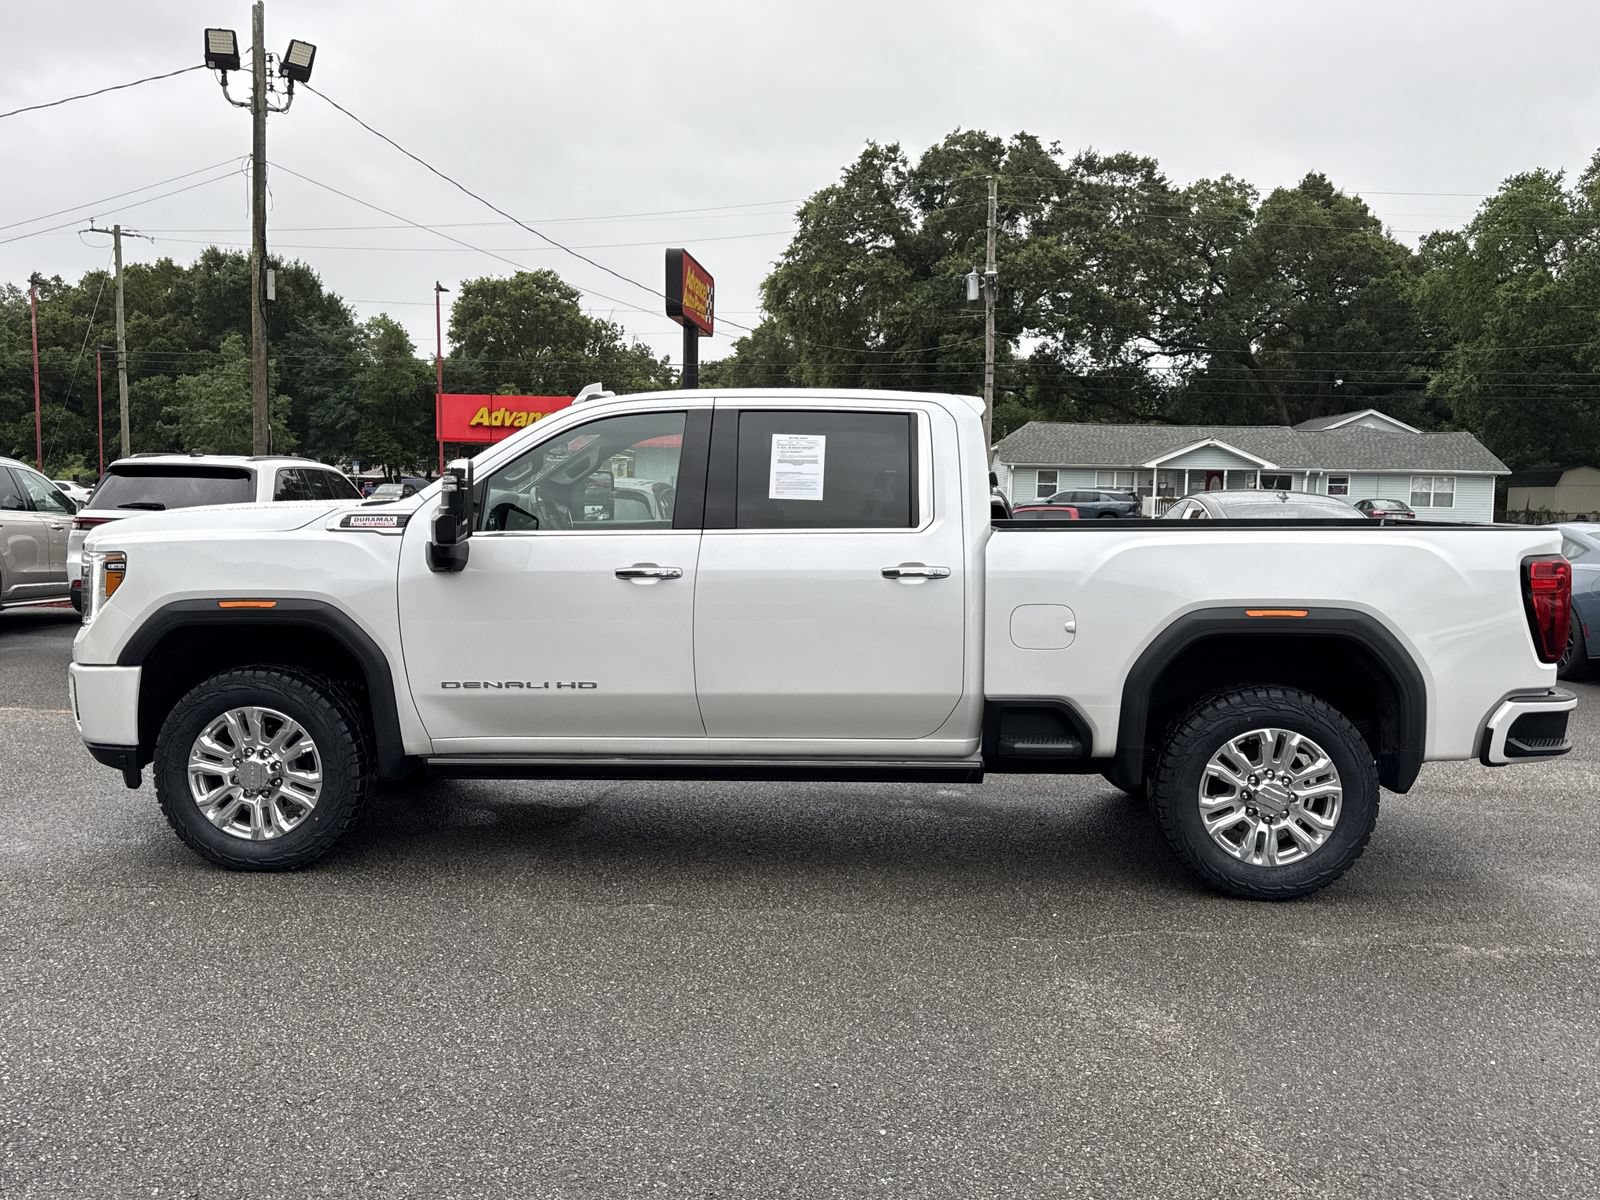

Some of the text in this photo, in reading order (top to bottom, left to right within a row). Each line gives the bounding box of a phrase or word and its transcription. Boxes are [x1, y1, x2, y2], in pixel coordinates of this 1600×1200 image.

[469, 407, 553, 427] Advan
[441, 681, 598, 689] DENALI HD
